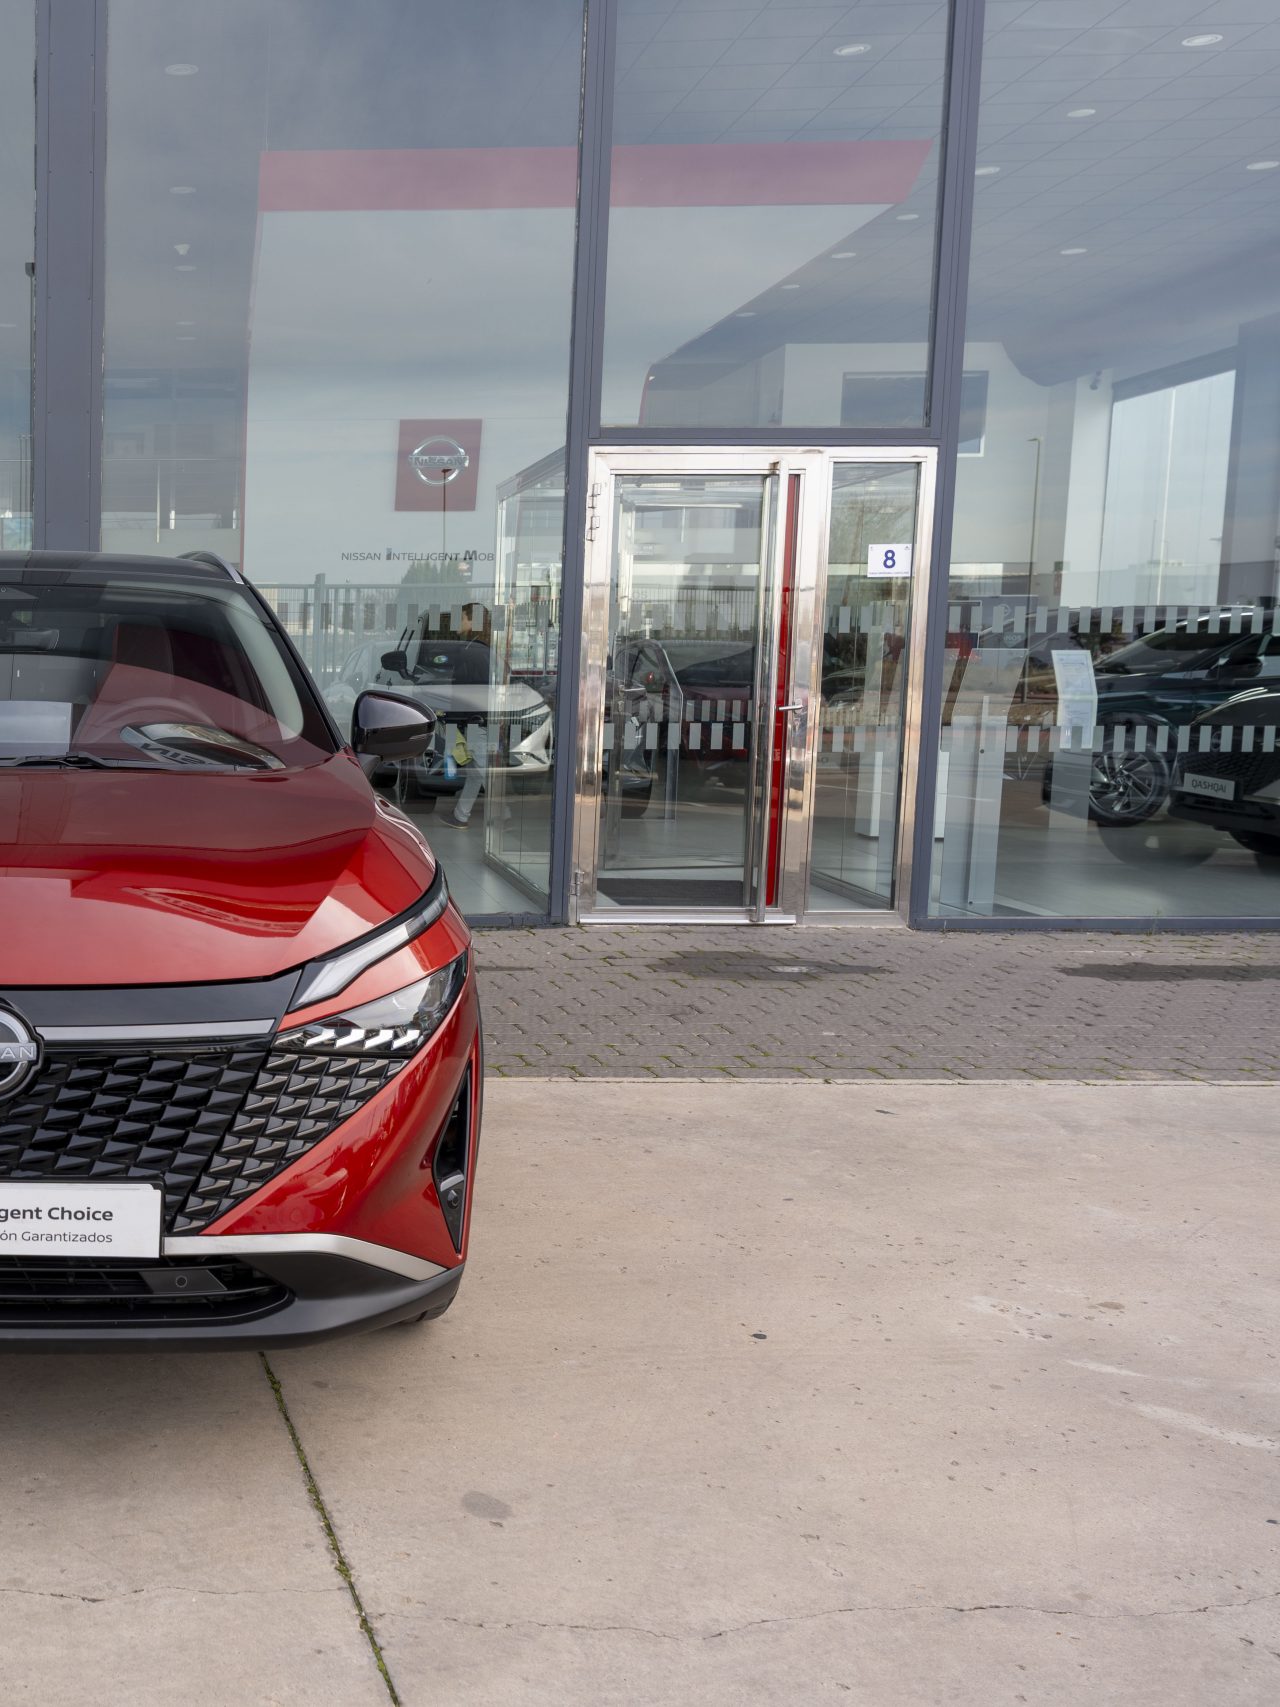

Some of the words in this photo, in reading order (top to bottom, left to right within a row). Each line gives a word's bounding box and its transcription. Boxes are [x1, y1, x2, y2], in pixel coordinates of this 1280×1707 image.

[413, 455, 465, 467] NISSAN
[341, 552, 381, 561] NISSAN
[883, 549, 896, 569] 8
[1191, 779, 1227, 793] QASHQAI
[47, 1206, 114, 1221] Choice
[21, 1230, 113, 1243] Garantizados
